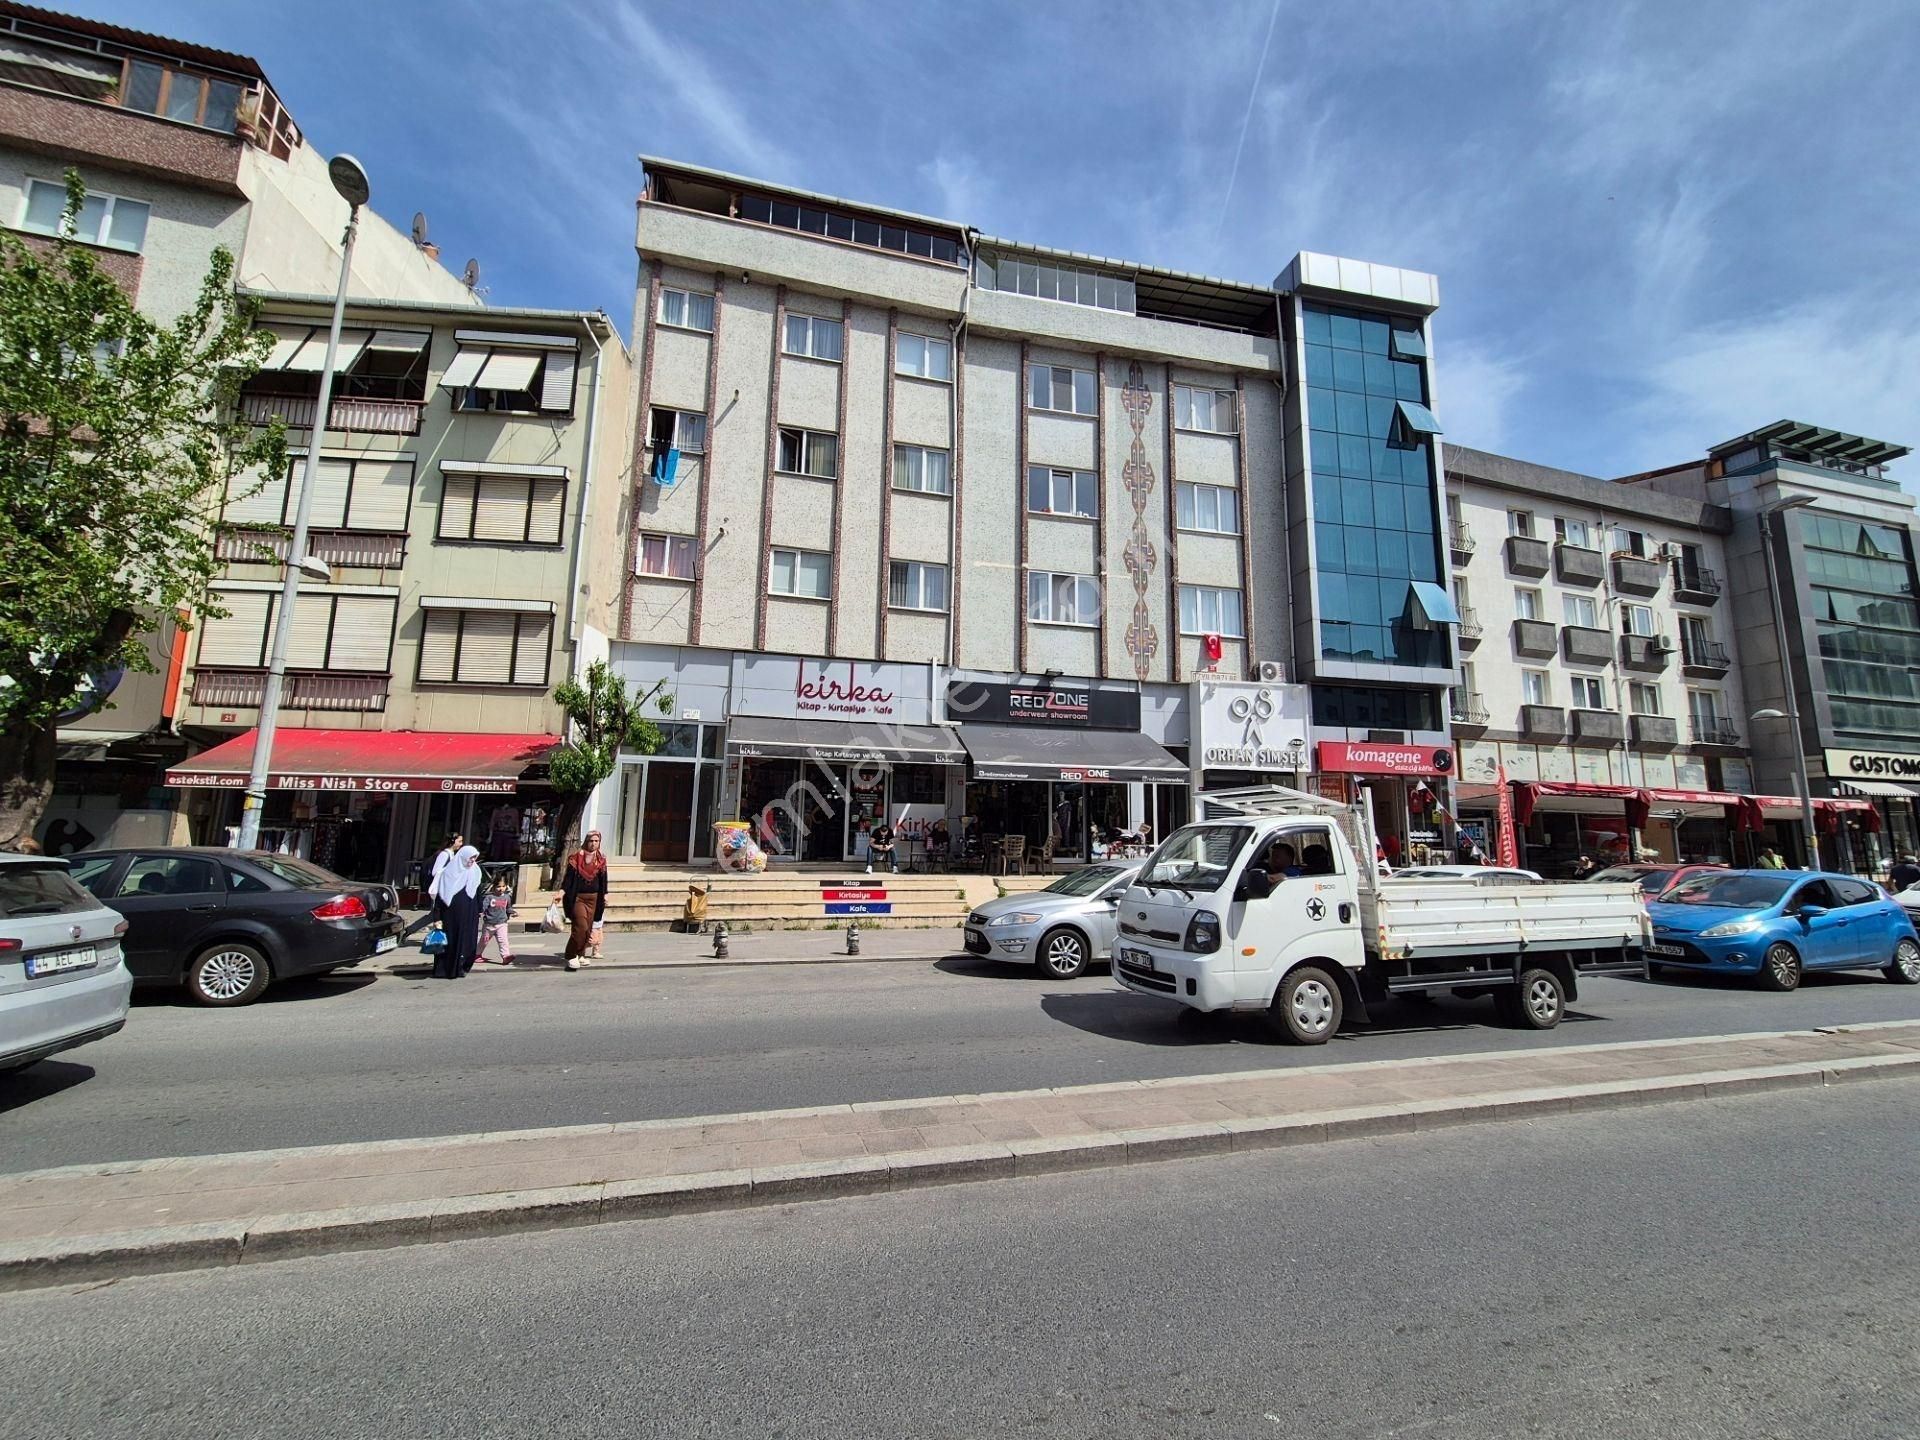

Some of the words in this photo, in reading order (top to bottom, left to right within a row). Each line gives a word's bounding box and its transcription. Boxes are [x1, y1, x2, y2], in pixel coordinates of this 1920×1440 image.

[797, 658, 893, 703] kirka
[1010, 690, 1089, 711] REDZONE
[797, 702, 821, 712] Kitap
[873, 706, 893, 715] Kafe
[1009, 710, 1048, 718] underwear
[1050, 712, 1088, 720] showroom
[1207, 749, 1255, 763] ORHAN
[1346, 745, 1421, 767] komagene
[168, 775, 244, 786] estekstil.com
[278, 776, 315, 789] Miss
[320, 777, 357, 789] Nish
[364, 777, 409, 790] Store
[455, 782, 513, 792] missnish.tr
[839, 892, 871, 900] Kırtasiye
[849, 905, 868, 913] Kafe
